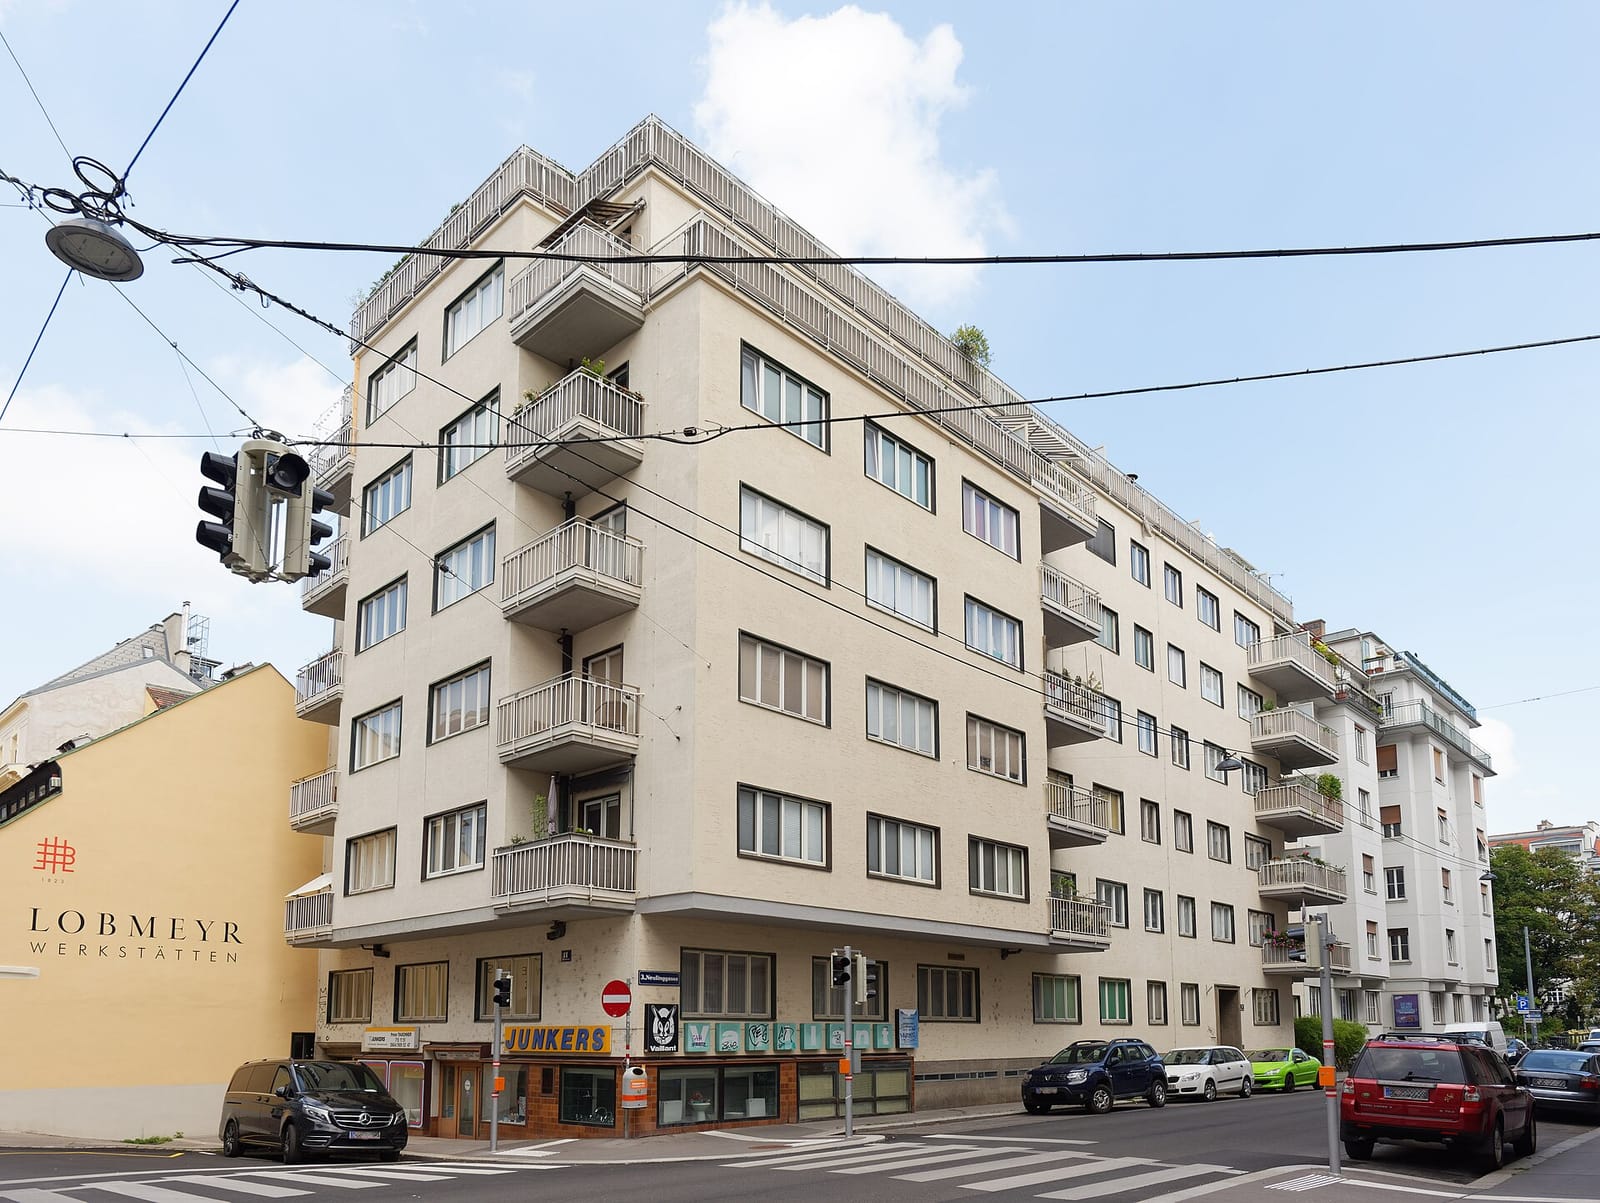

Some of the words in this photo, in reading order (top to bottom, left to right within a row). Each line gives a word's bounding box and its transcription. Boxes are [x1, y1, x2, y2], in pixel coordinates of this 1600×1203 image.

[28, 906, 245, 945] LOBMEYR
[29, 940, 238, 963] WERKSTÄTTEN
[505, 1026, 605, 1051] JUNKERS
[649, 1044, 677, 1052] Vaillant
